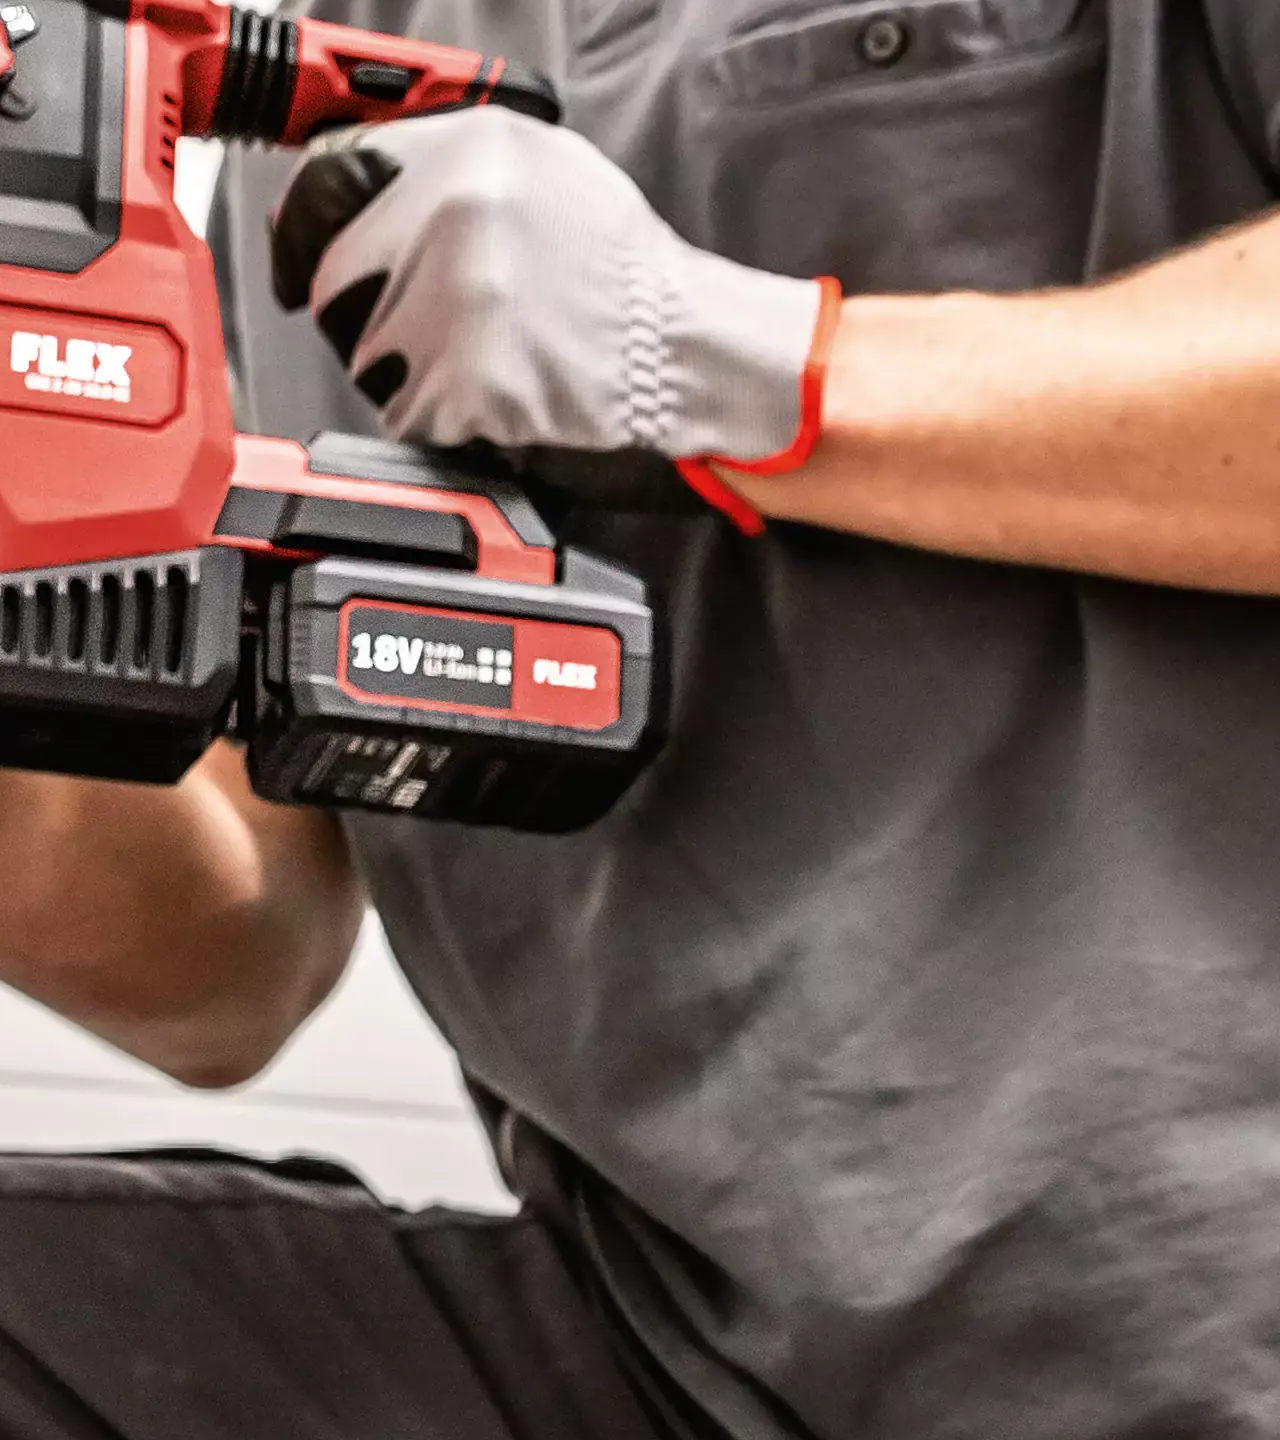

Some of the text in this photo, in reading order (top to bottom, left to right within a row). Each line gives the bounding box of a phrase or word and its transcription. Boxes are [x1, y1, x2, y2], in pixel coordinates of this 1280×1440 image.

[10, 331, 133, 387] FLEX
[351, 632, 424, 675] 18V
[533, 659, 597, 689] FLEX
